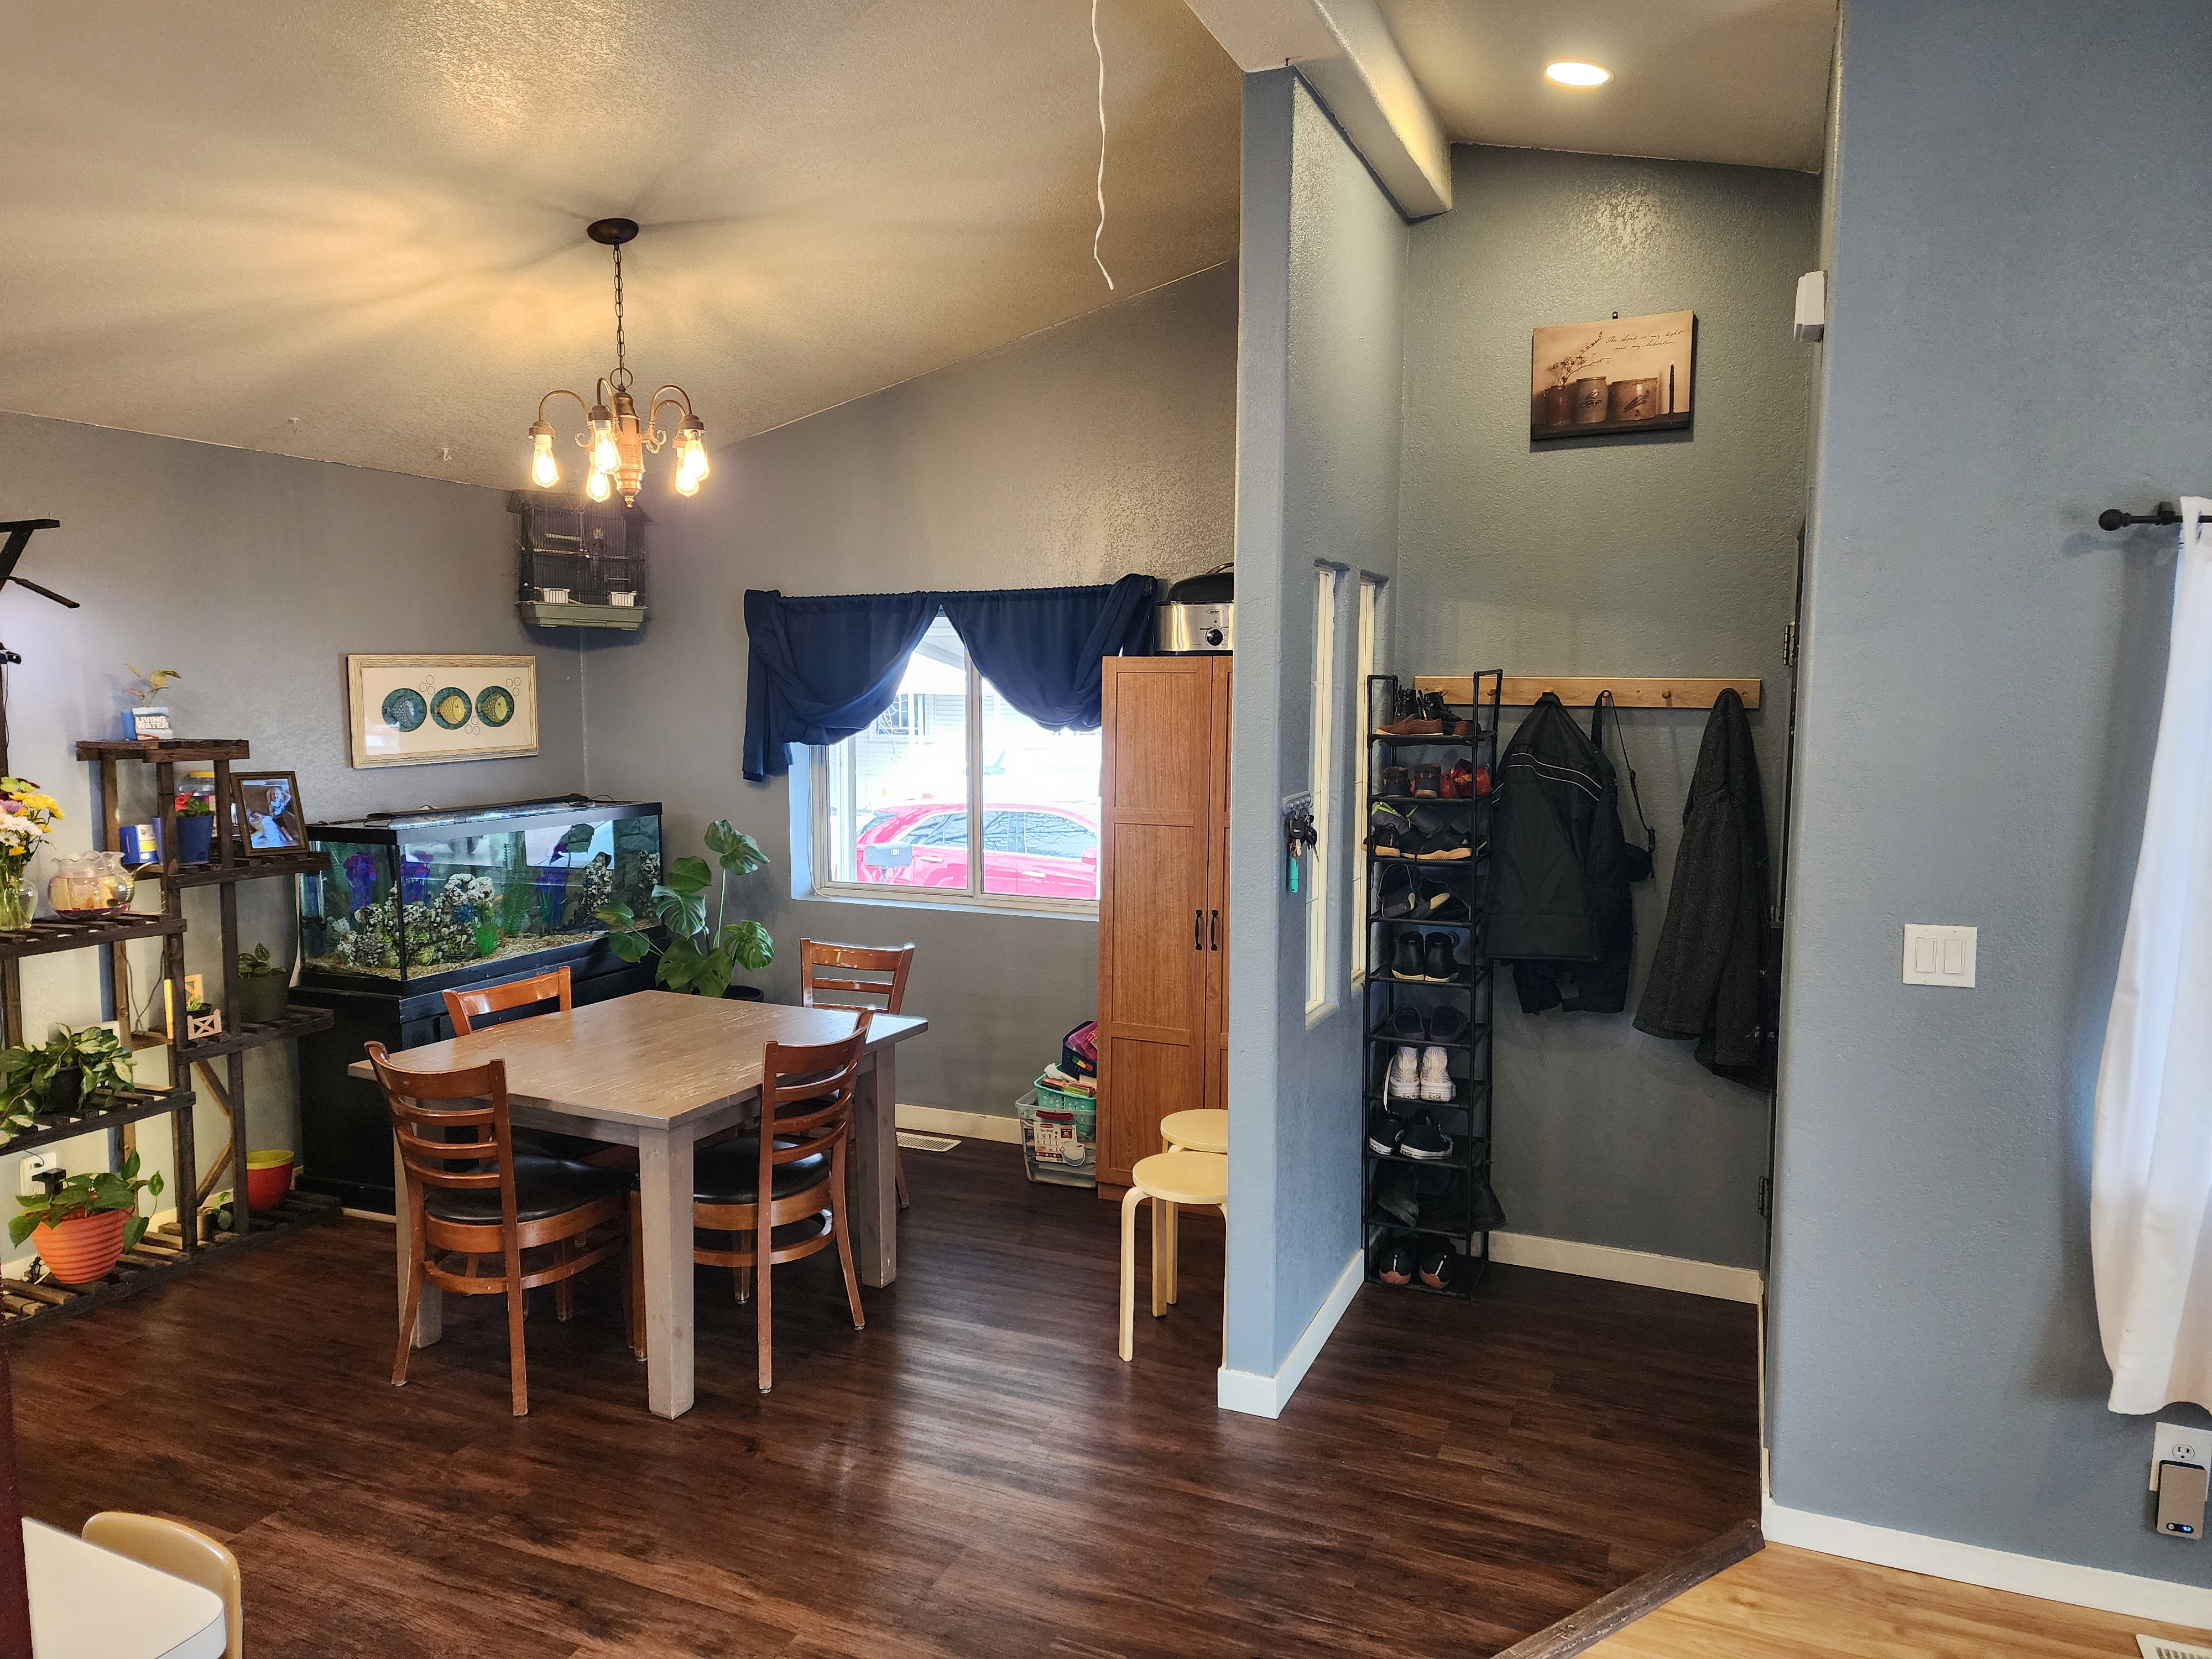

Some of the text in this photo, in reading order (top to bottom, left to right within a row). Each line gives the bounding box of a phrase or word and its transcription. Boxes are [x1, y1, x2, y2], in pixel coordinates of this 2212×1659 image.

[1605, 335, 1617, 343] The
[1621, 333, 1638, 342] Lord
[1665, 329, 1684, 338] light
